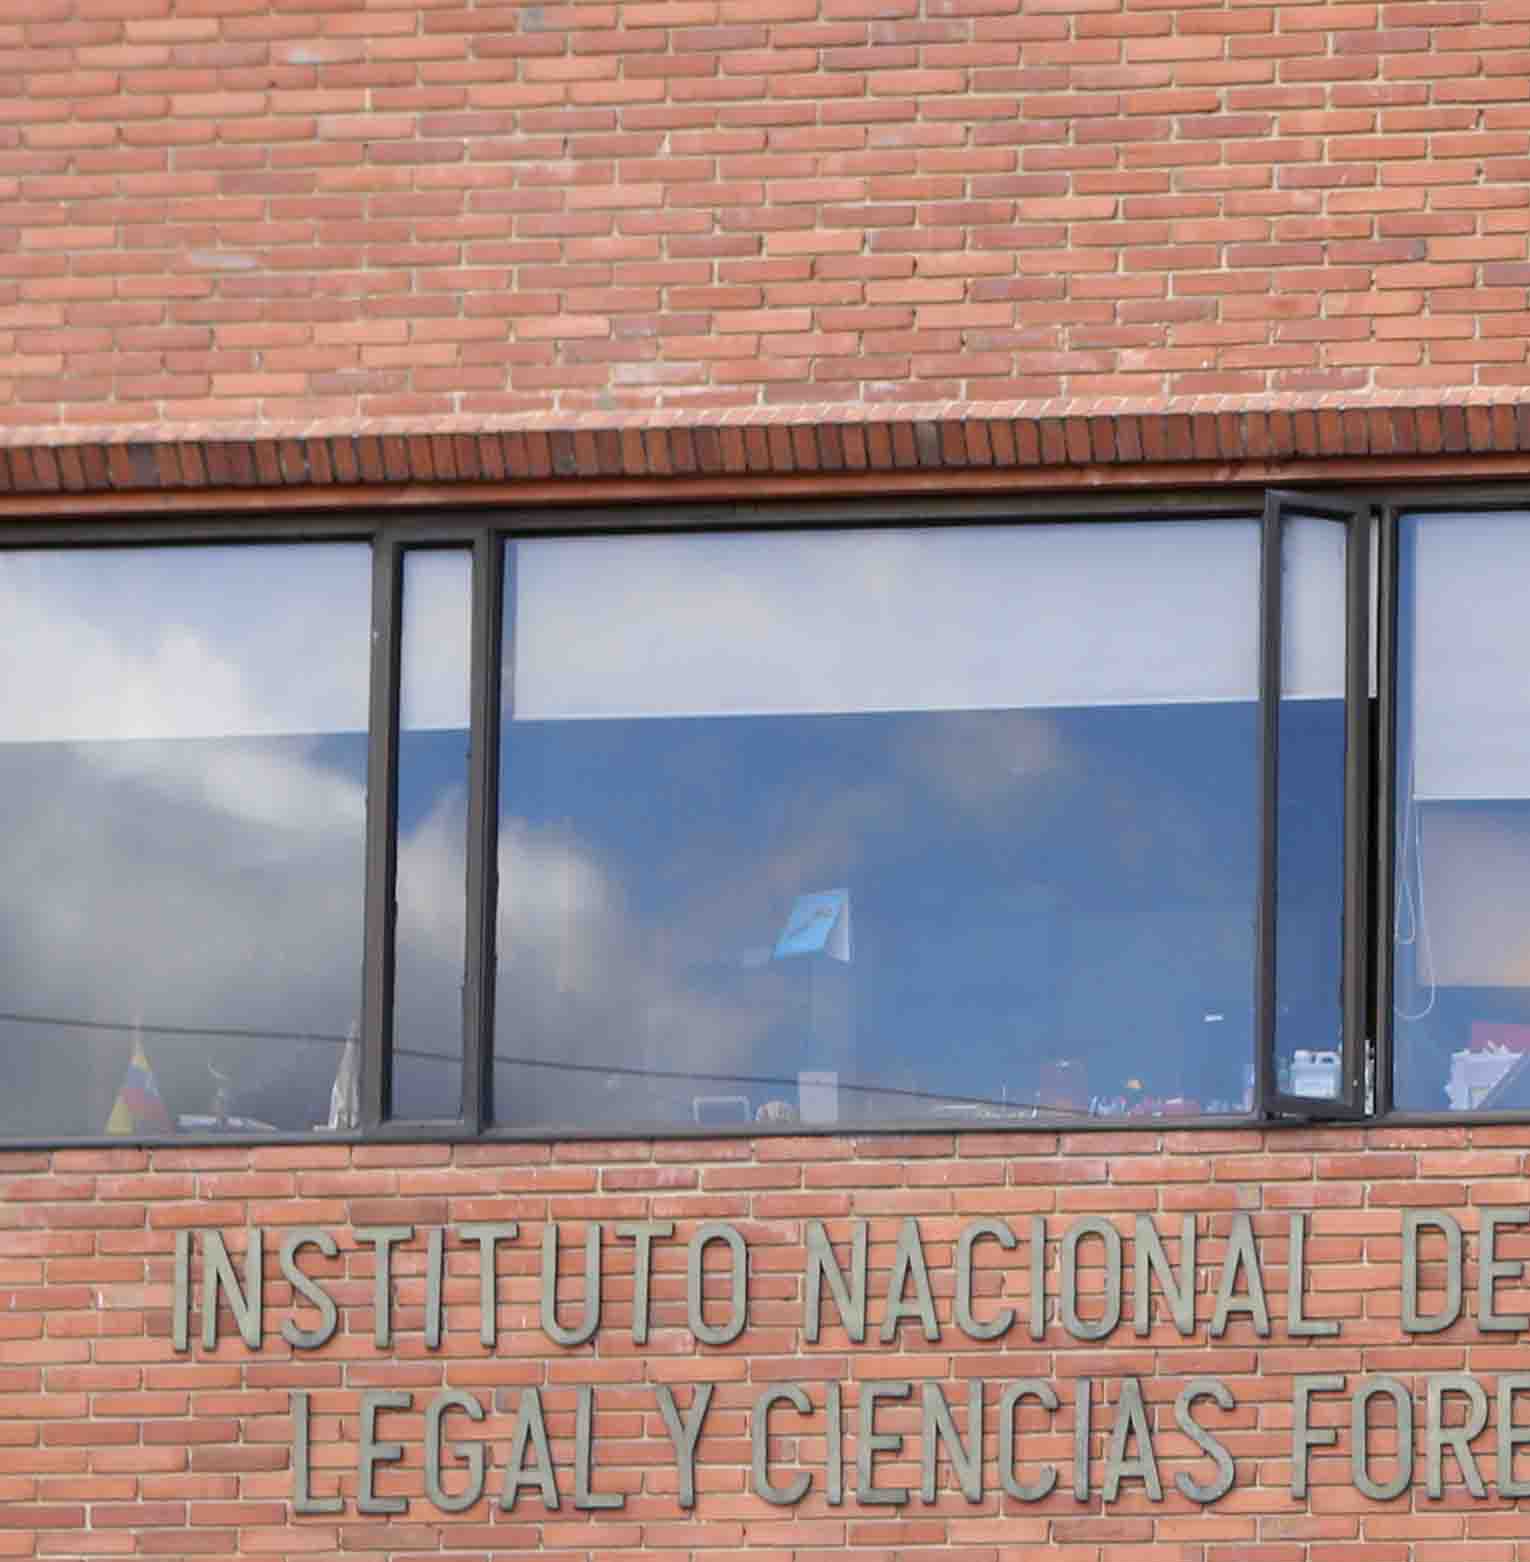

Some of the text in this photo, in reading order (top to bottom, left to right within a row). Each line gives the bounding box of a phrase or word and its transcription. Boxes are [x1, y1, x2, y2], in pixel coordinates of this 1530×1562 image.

[171, 1222, 748, 1352] INSTITUTO
[803, 1211, 1342, 1344] NACIONAL
[290, 1385, 627, 1515] LEGAL
[655, 1382, 715, 1510] Y
[751, 1376, 1235, 1505] CIENCIAS
